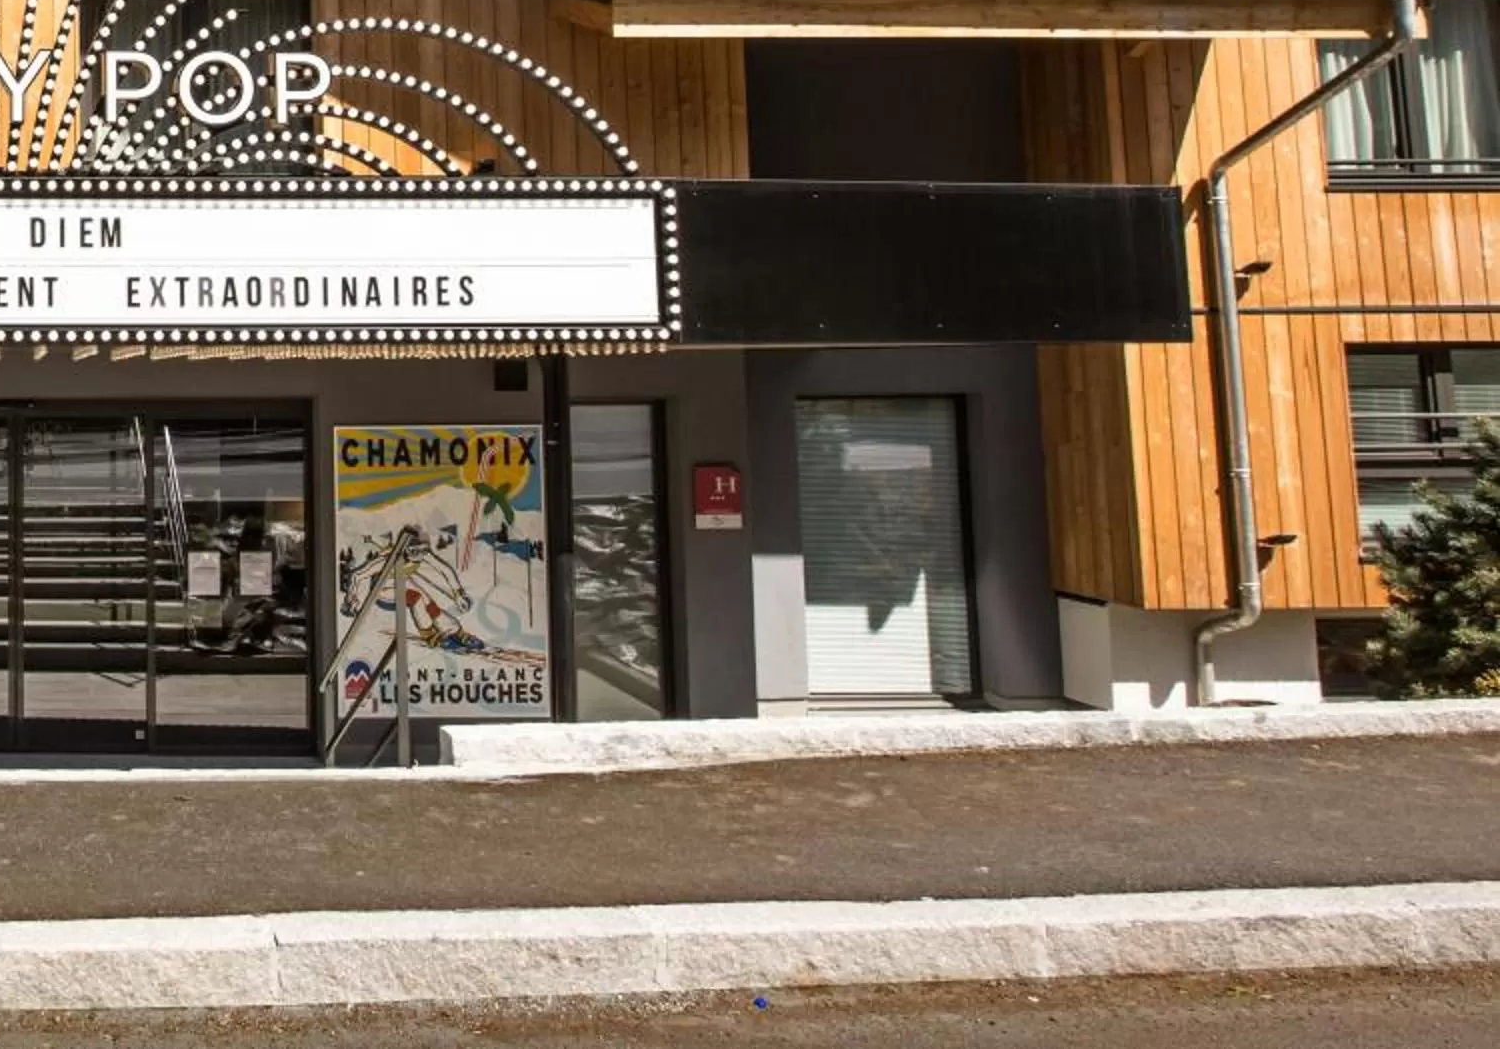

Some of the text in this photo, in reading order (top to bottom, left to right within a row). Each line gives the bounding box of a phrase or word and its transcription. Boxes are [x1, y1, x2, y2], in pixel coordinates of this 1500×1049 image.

[105, 50, 332, 125] POP
[30, 216, 122, 248] DIEM
[126, 275, 474, 308] EXTRAORDINAIRES
[341, 436, 537, 468] CHAMONIX
[379, 668, 544, 682] MNT-BLANC
[430, 683, 544, 704] HOUCHES
